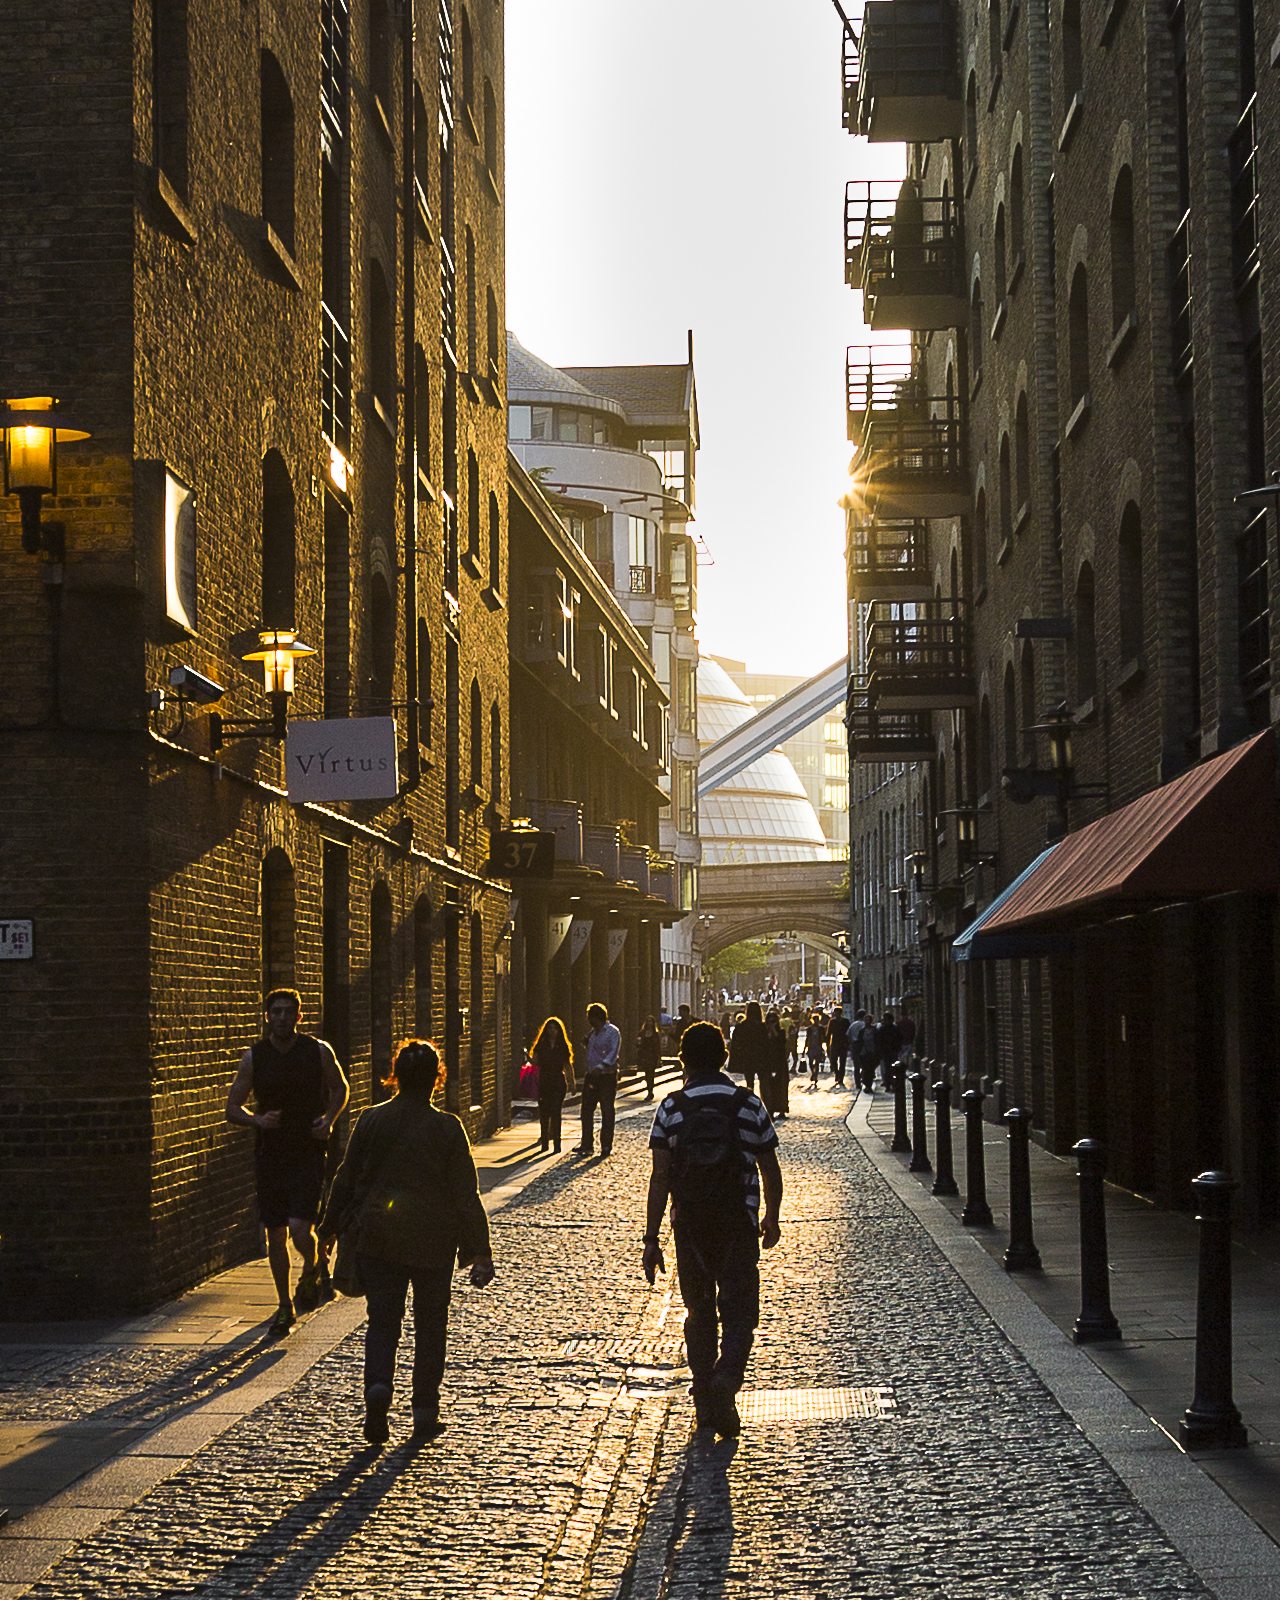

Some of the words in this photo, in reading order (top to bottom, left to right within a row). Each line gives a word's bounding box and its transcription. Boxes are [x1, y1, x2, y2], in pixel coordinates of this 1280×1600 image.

[295, 746, 388, 775] Virtus
[504, 842, 538, 868] 37
[551, 922, 564, 935] 41
[573, 927, 587, 939] 43
[11, 932, 29, 944] SE1
[610, 935, 622, 946] 45
